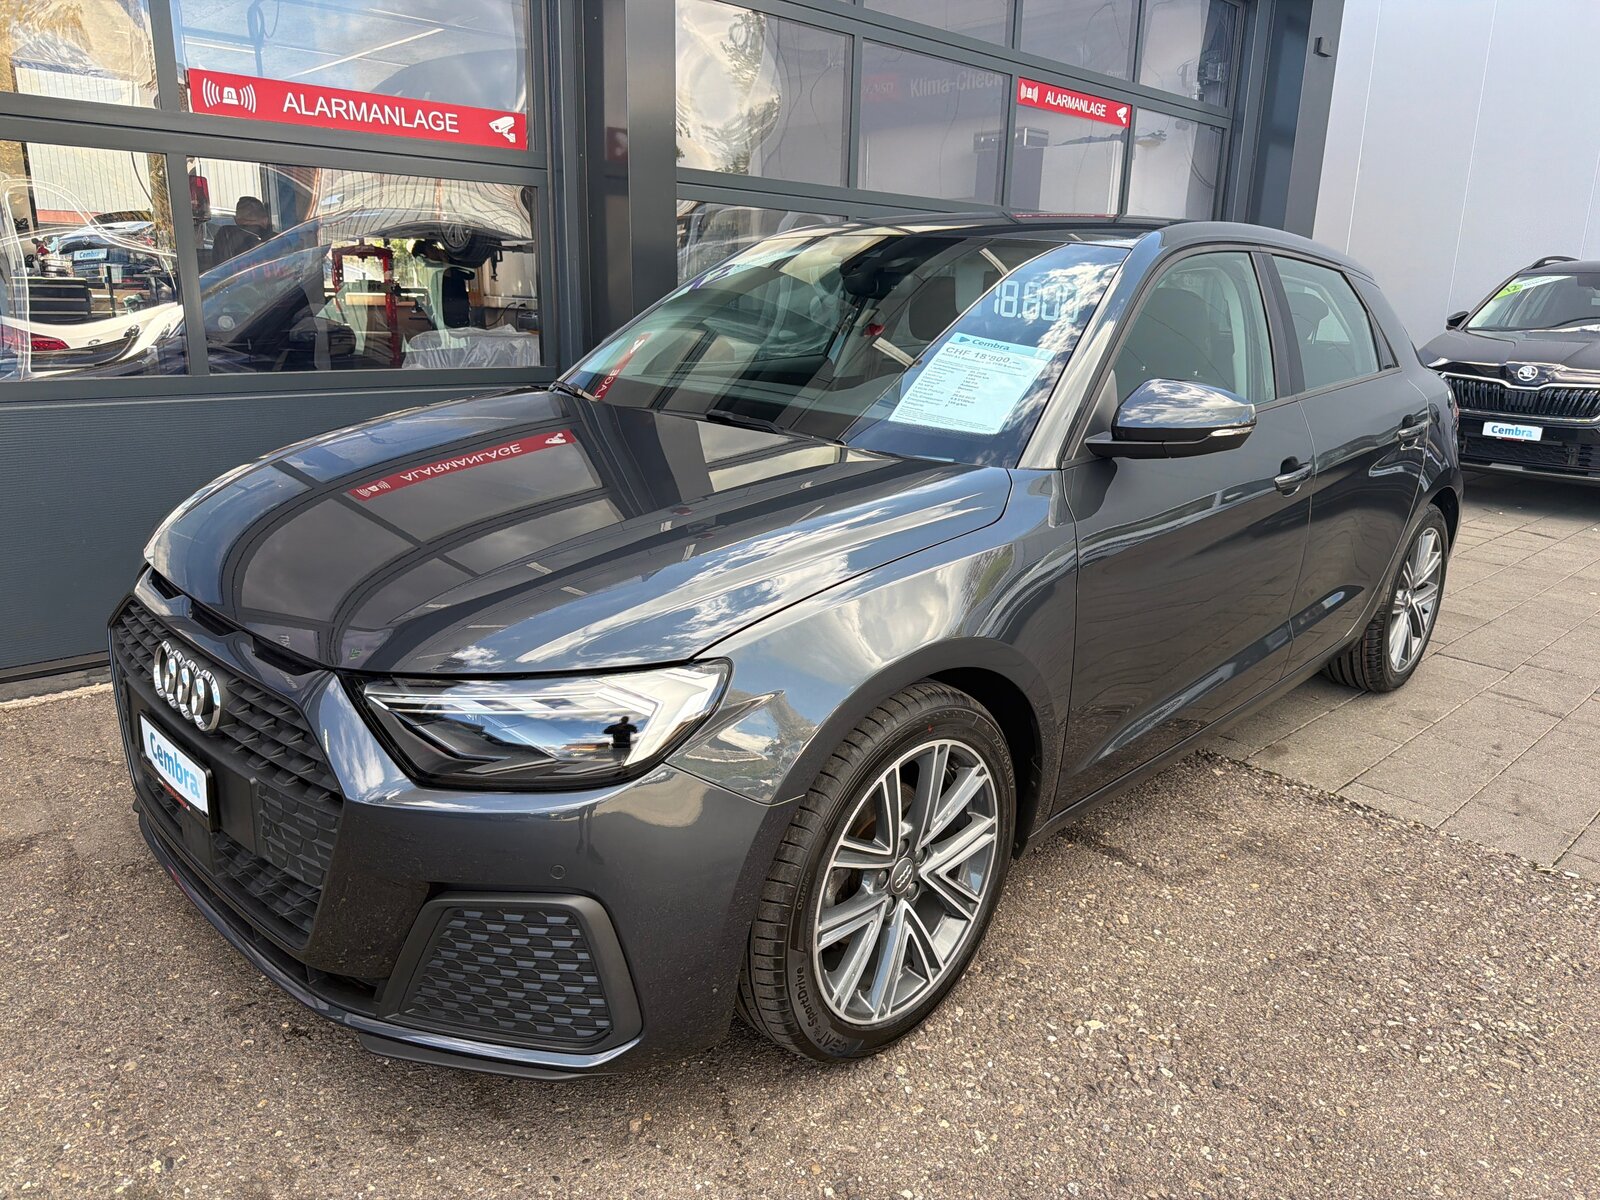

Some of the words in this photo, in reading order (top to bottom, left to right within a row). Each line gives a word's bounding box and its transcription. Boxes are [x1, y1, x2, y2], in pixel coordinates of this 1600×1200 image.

[282, 91, 460, 134] ALARMANLAGE
[1045, 90, 1107, 118] ALARMANLAGE
[992, 280, 1080, 322] 18.800
[945, 346, 971, 358] CHF
[972, 338, 1010, 351] Cembra
[1491, 425, 1533, 438] Cembra
[149, 731, 201, 799] Cembra
[795, 965, 819, 1028] SportDrive
